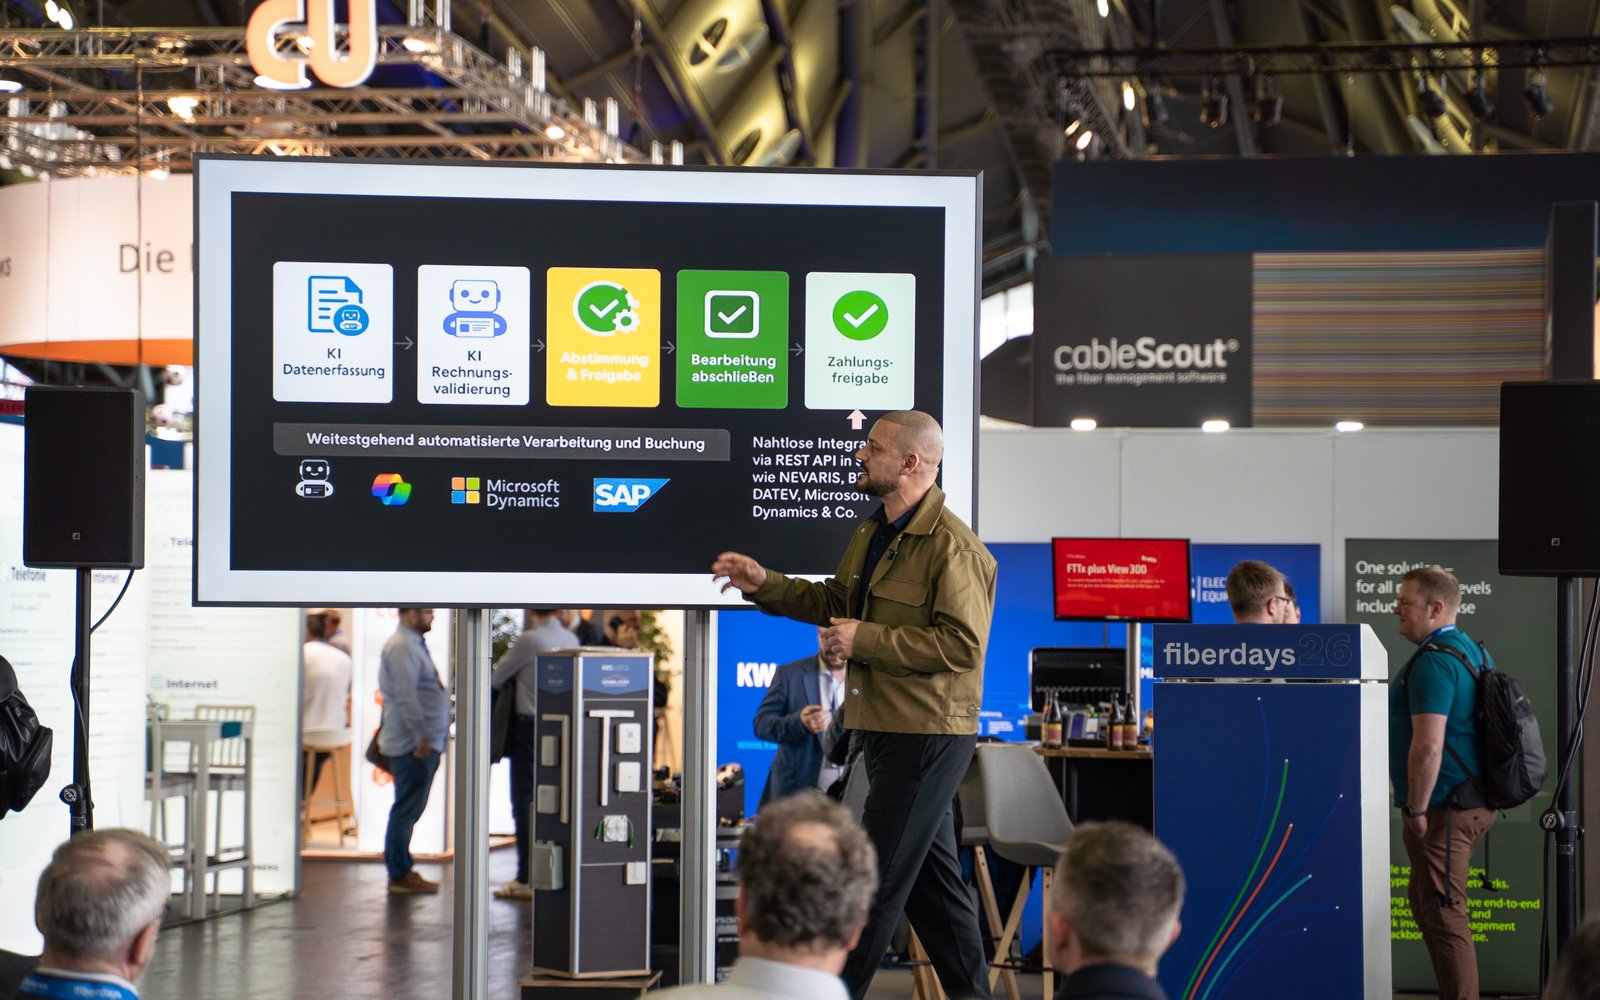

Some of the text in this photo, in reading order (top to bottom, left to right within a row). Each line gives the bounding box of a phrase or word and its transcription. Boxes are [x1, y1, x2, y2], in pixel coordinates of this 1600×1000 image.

[119, 242, 175, 274] Die
[327, 348, 342, 359] KI
[467, 351, 482, 361] KI
[560, 352, 649, 367] Abstimmung
[691, 354, 777, 370] Bearbeitung
[828, 356, 894, 369] Zahlungs-
[283, 364, 385, 379] Datenerfassung
[432, 366, 513, 380] Rechnungs-
[566, 369, 642, 384] & Freigabe
[832, 372, 889, 386] freigabe
[1055, 371, 1228, 387] the fiber management software
[433, 383, 511, 398] validierung
[307, 433, 705, 452] Weitestgehend automatisierte Verarbeitung und Buchung
[753, 436, 870, 453] Nahtlose Integra
[752, 455, 772, 467] via
[775, 455, 810, 467] REST
[812, 455, 837, 467] API
[840, 455, 851, 467] in
[487, 479, 560, 493] Microsoft
[752, 472, 776, 484] wie
[779, 471, 845, 486] NEVARIS,
[487, 494, 560, 510] Dynamics
[595, 483, 651, 506] SAP
[753, 489, 801, 502] DATEV,
[753, 506, 858, 520] Dynamics & Co.
[1066, 563, 1147, 577] FTTx plus View 300
[1355, 560, 1385, 575] One
[1202, 576, 1228, 590] ELEC
[1355, 579, 1376, 594] for
[1377, 580, 1393, 594] all
[1459, 581, 1492, 595] evels
[1164, 643, 1296, 671] fiberdays
[736, 661, 777, 688] KW
[167, 678, 218, 689] Internet
[1483, 898, 1541, 911] end-to-end
[1472, 909, 1492, 920] and
[1469, 922, 1517, 934] agement
